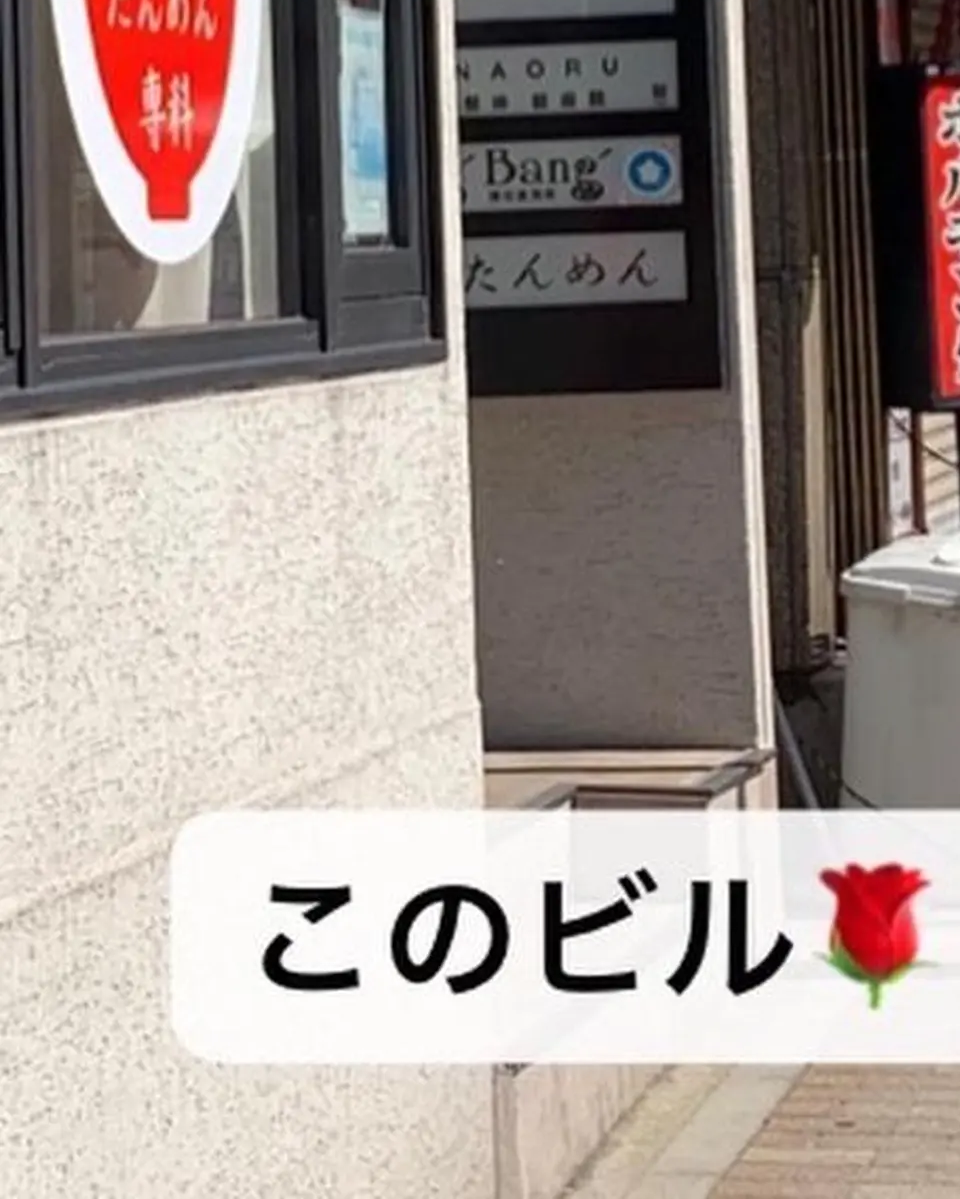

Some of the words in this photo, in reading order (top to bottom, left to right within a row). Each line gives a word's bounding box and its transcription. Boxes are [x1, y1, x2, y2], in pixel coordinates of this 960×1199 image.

[138, 64, 196, 152] 専科
[465, 247, 659, 293] たんめん
